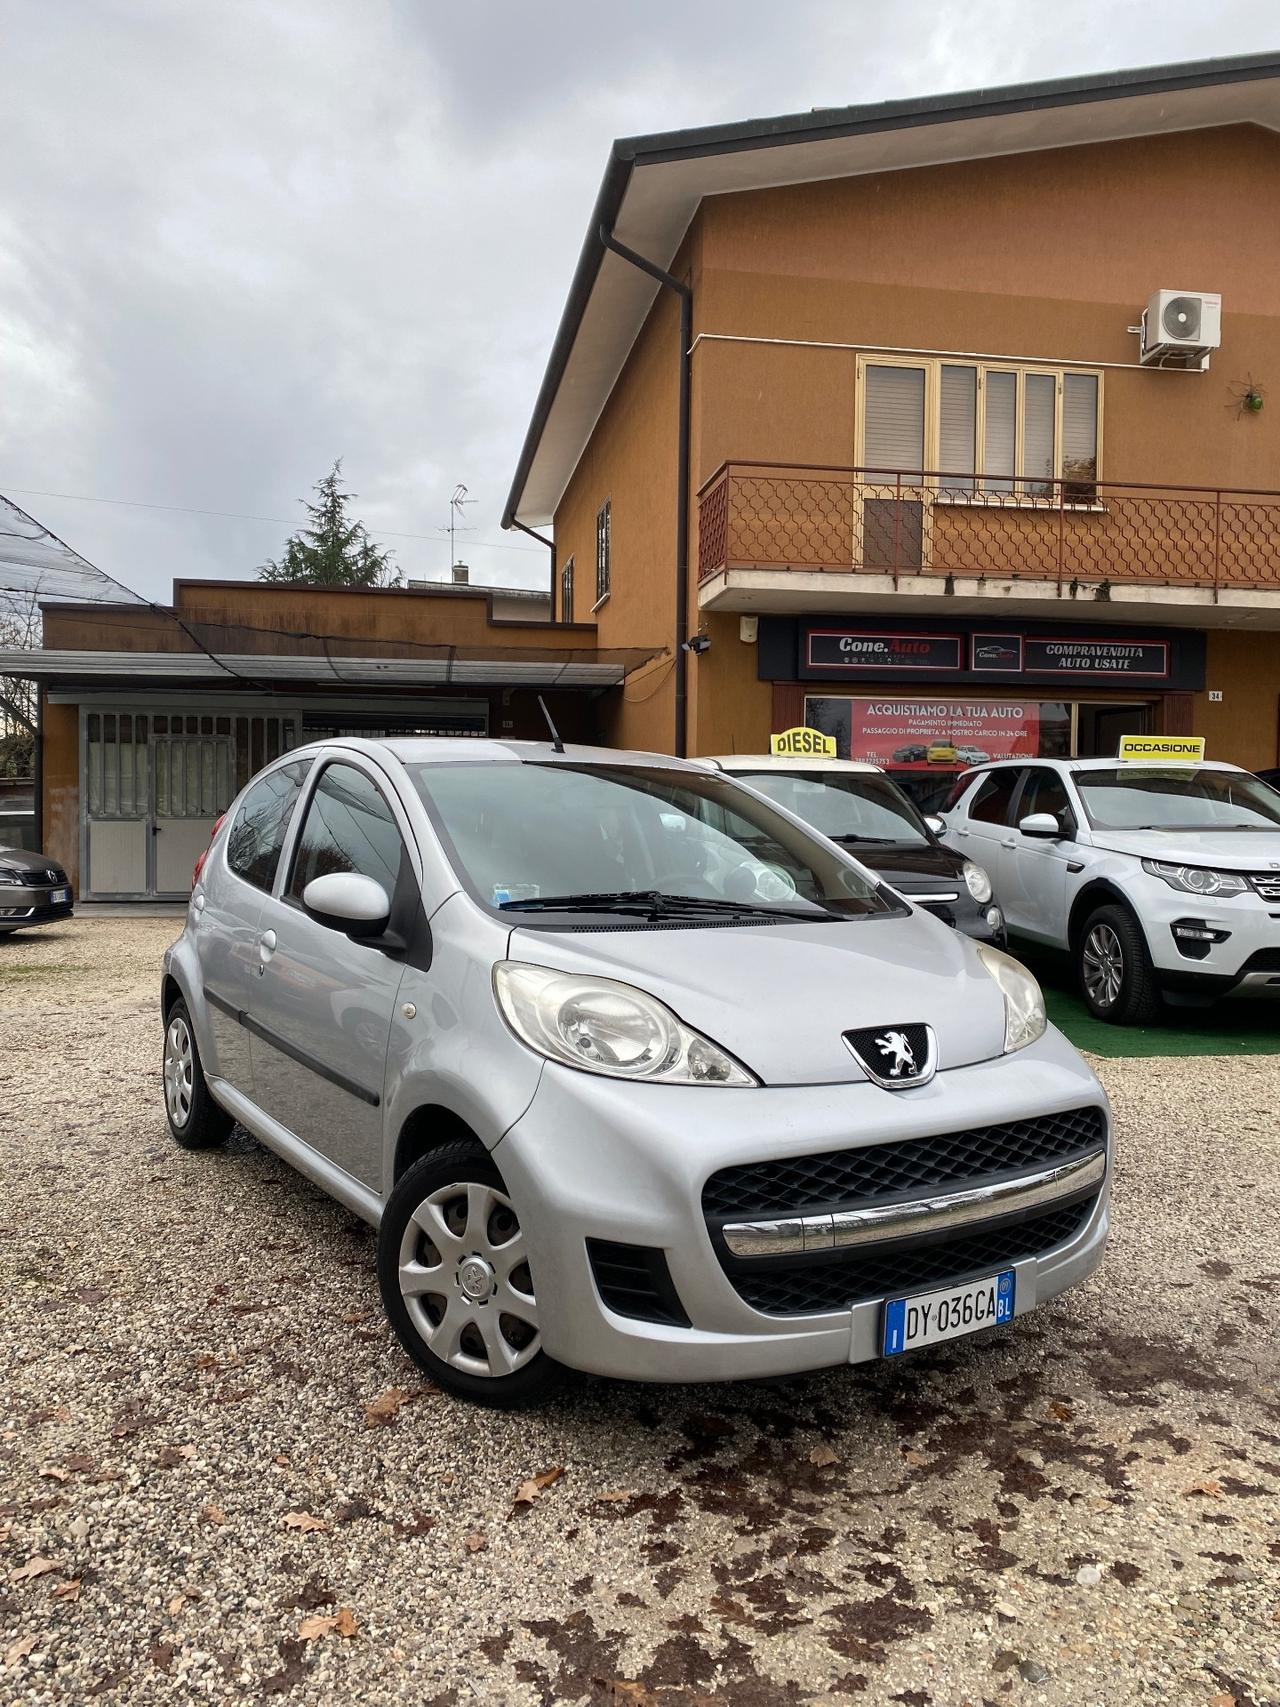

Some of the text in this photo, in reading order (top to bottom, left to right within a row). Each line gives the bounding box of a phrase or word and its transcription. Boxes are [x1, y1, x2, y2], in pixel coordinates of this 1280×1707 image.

[1046, 644, 1143, 657] COMPRAVENDITA
[1058, 657, 1131, 669] AUTO USATE
[1211, 692, 1219, 700] 34
[867, 704, 1023, 718] ACQUISTIAMO LA TUA AUTO
[908, 719, 946, 727] PAGAMENTO
[777, 731, 831, 753] DIESEL
[1124, 743, 1200, 753] OCCASIONE
[998, 1297, 1011, 1318] BL
